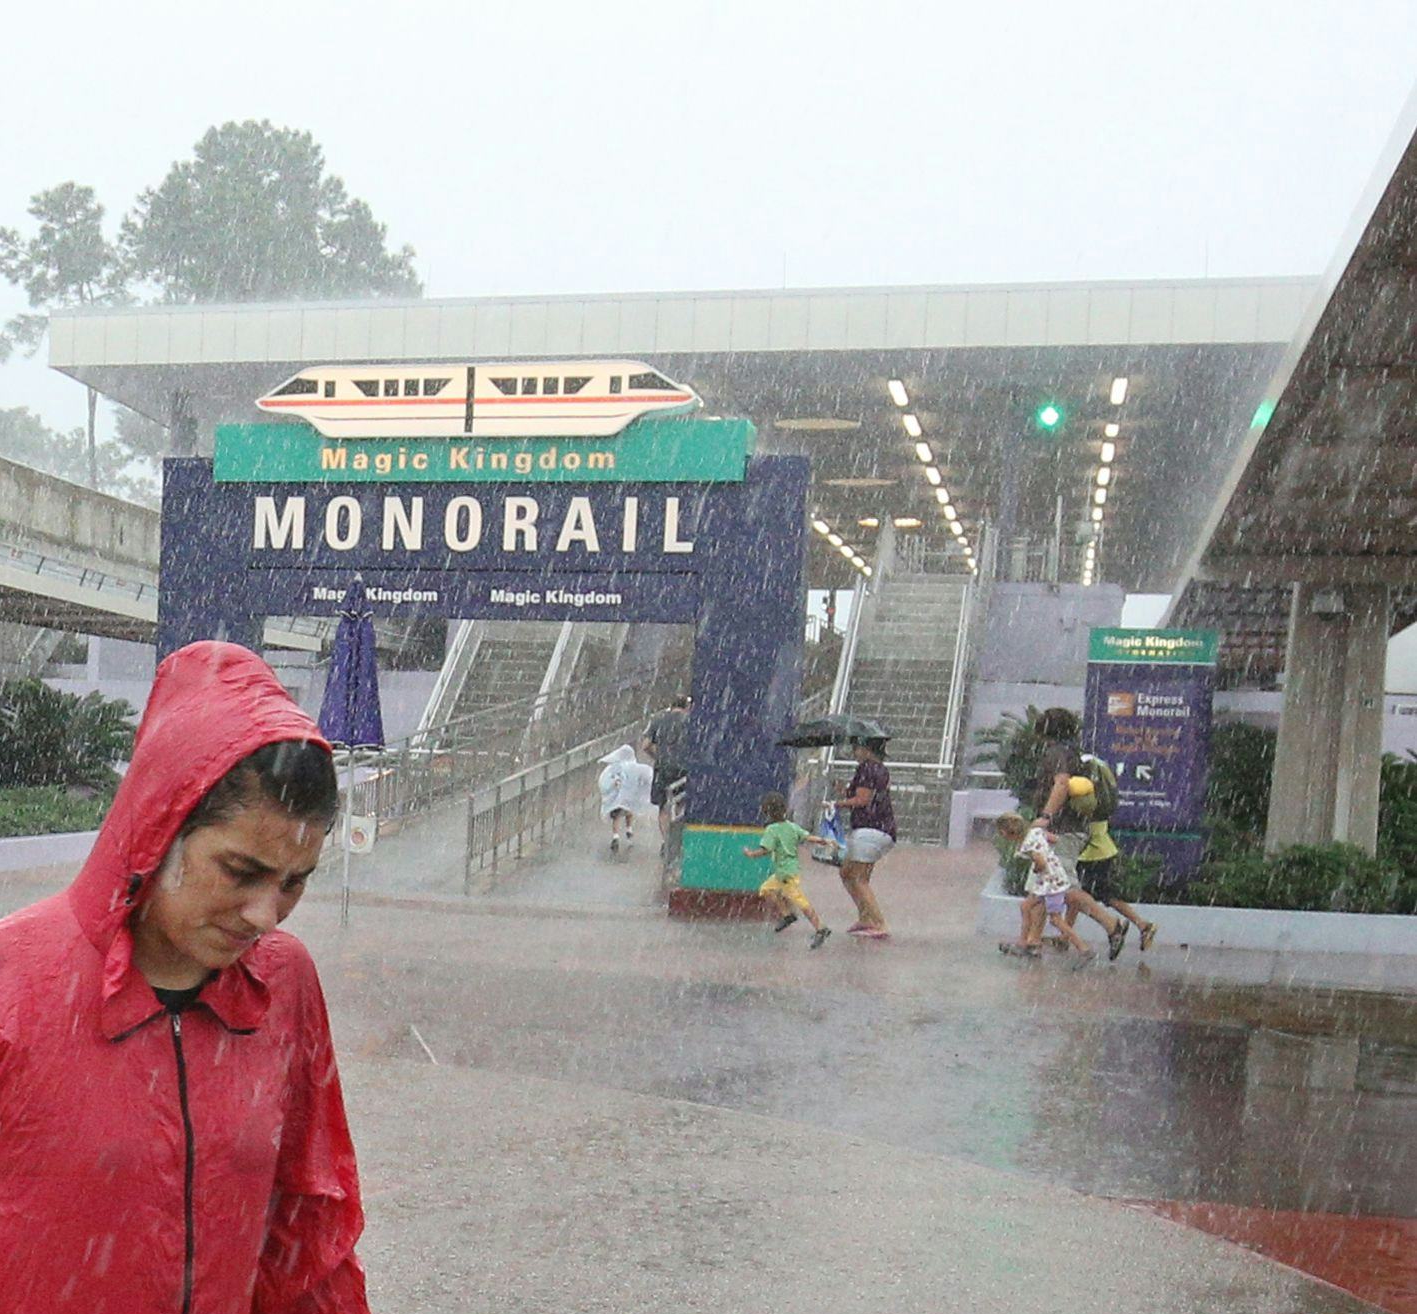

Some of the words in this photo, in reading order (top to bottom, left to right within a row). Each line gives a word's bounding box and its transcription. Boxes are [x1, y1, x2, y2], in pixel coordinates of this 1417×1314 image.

[321, 447, 429, 474] Magic
[450, 447, 616, 474] Kingdom
[252, 495, 694, 552] MONORAIL
[313, 587, 348, 604] Mag
[366, 586, 438, 603] Kingdom
[490, 588, 541, 605] Magic
[545, 589, 622, 605] Kingdom
[1103, 635, 1142, 648] Magic
[1145, 636, 1204, 649] Kingdom
[1137, 693, 1184, 706] Express
[1136, 705, 1191, 717] Monorail
